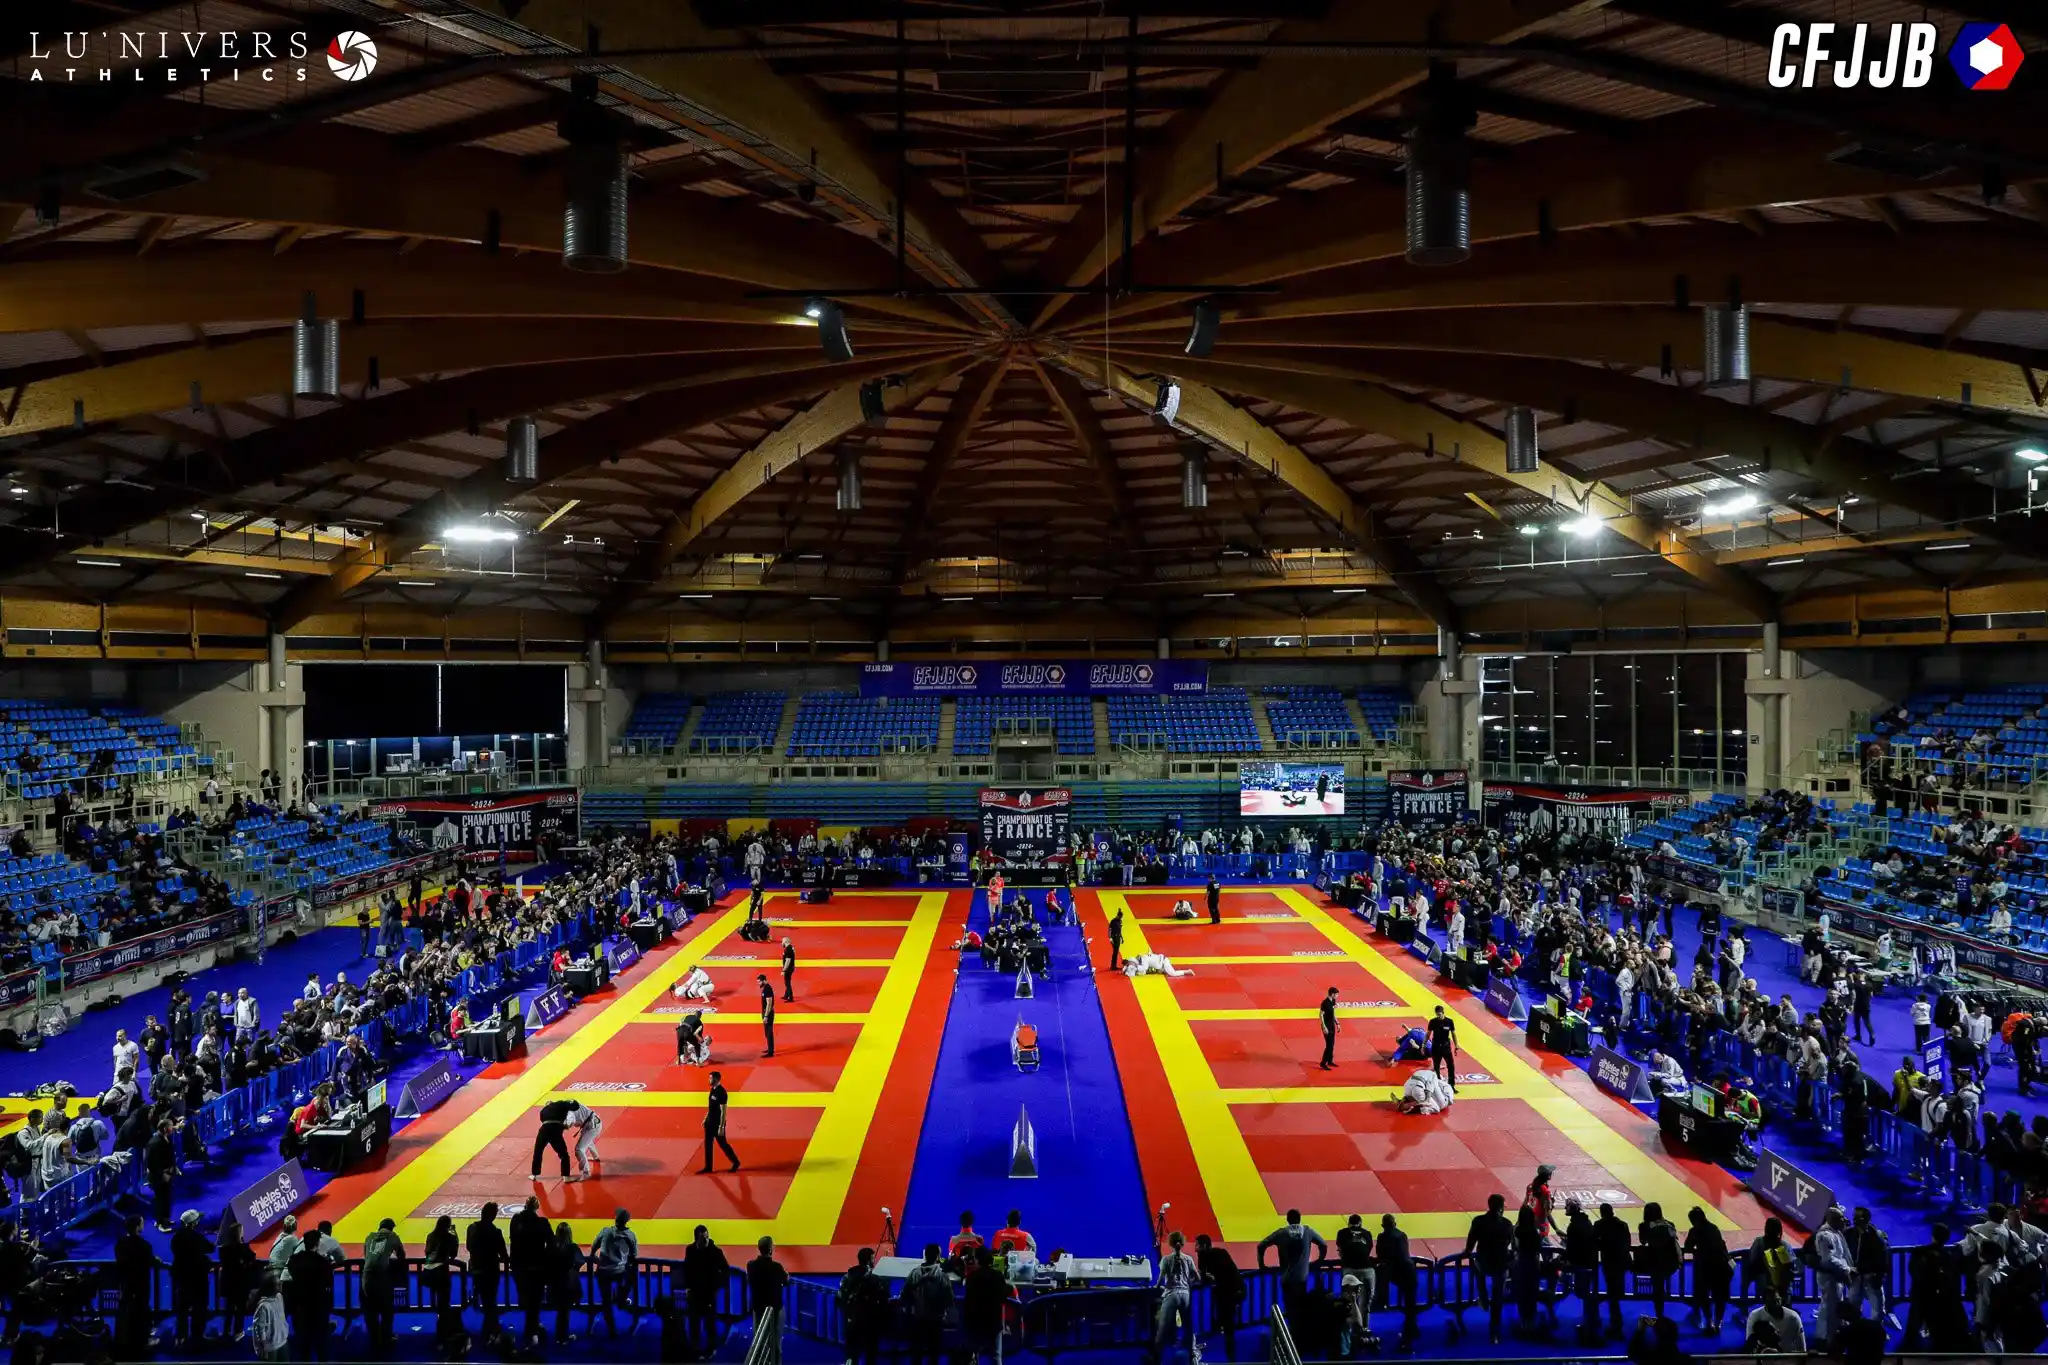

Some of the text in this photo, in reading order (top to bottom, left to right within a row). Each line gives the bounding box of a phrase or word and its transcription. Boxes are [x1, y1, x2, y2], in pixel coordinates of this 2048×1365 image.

[912, 665, 956, 685] CFJJB
[1001, 664, 1045, 684] CFJJB
[1089, 664, 1134, 684] CFJJB
[1403, 792, 1443, 802] CHAMPIONNAT
[1403, 800, 1452, 814] FRANCE
[461, 810, 532, 828] CHAMPIONNAT DE
[997, 814, 1053, 825] CHAMPIONNAT DE
[461, 821, 532, 846] FRANCE
[997, 824, 1053, 839] FRANCE
[1682, 1128, 1689, 1142] 5
[365, 1139, 372, 1153] 6
[249, 1188, 281, 1217] athletes
